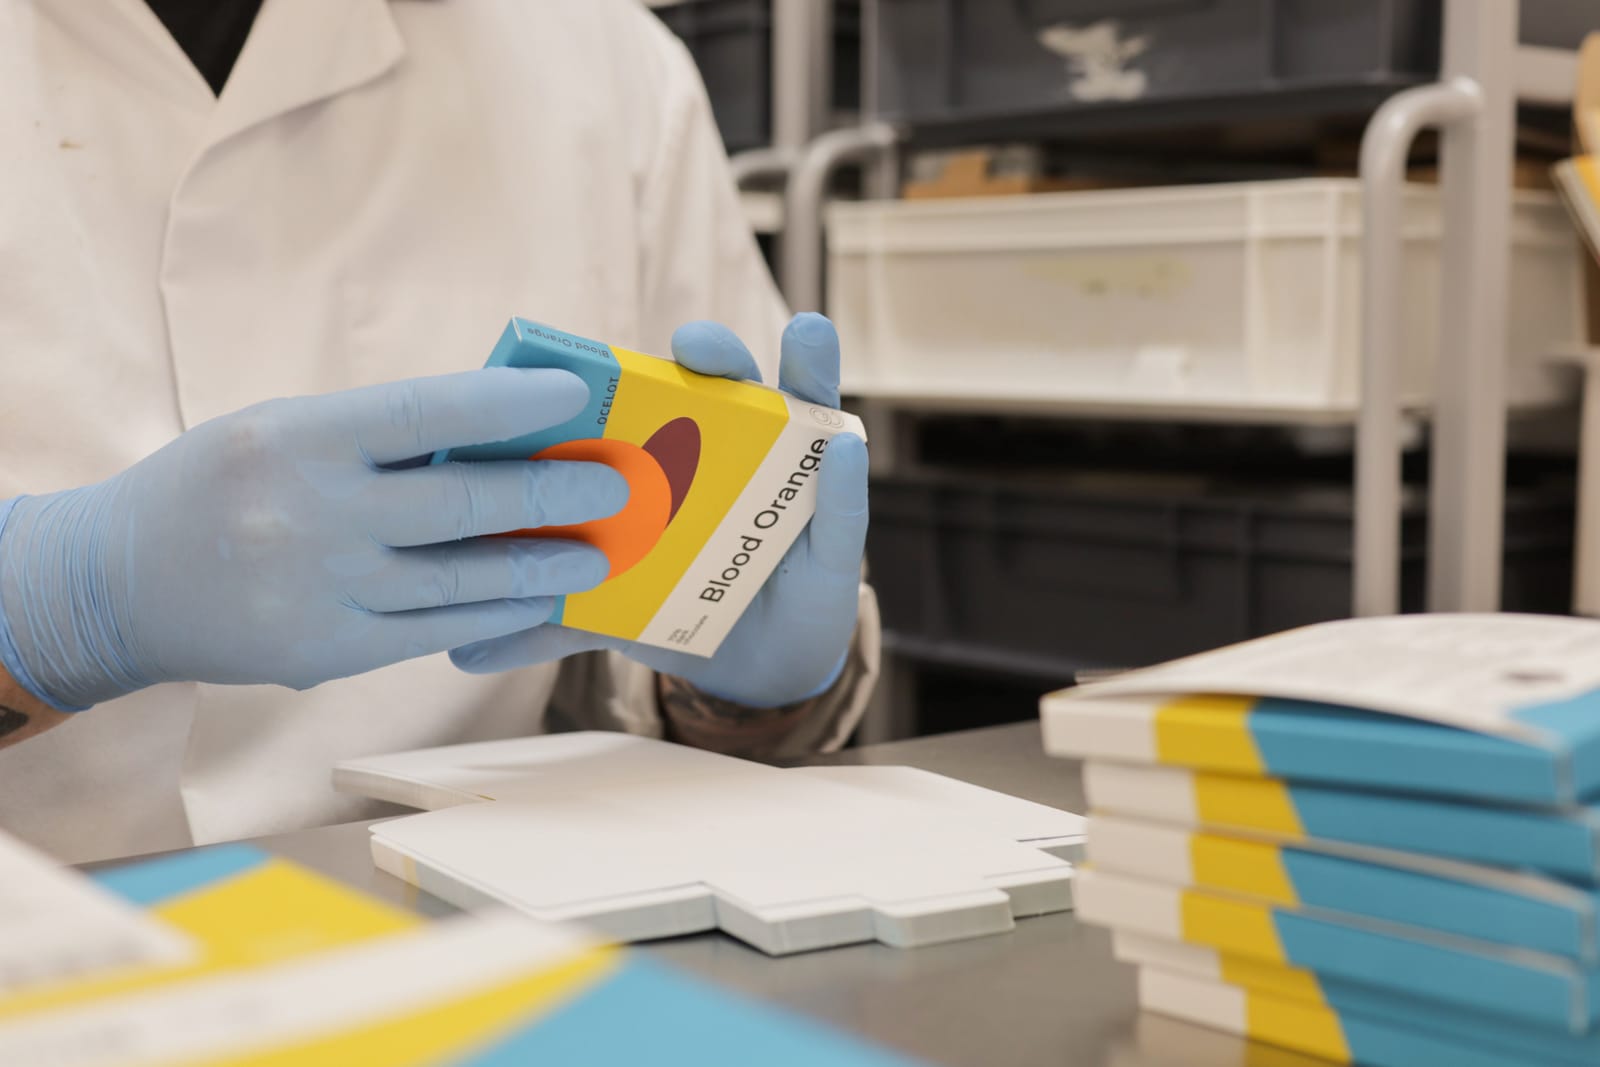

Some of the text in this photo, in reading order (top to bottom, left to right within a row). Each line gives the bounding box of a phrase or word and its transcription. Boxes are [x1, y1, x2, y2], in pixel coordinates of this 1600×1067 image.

[527, 327, 610, 359] Blood Orange
[596, 376, 619, 425] OCELOT
[698, 438, 829, 603] Blood Orange
